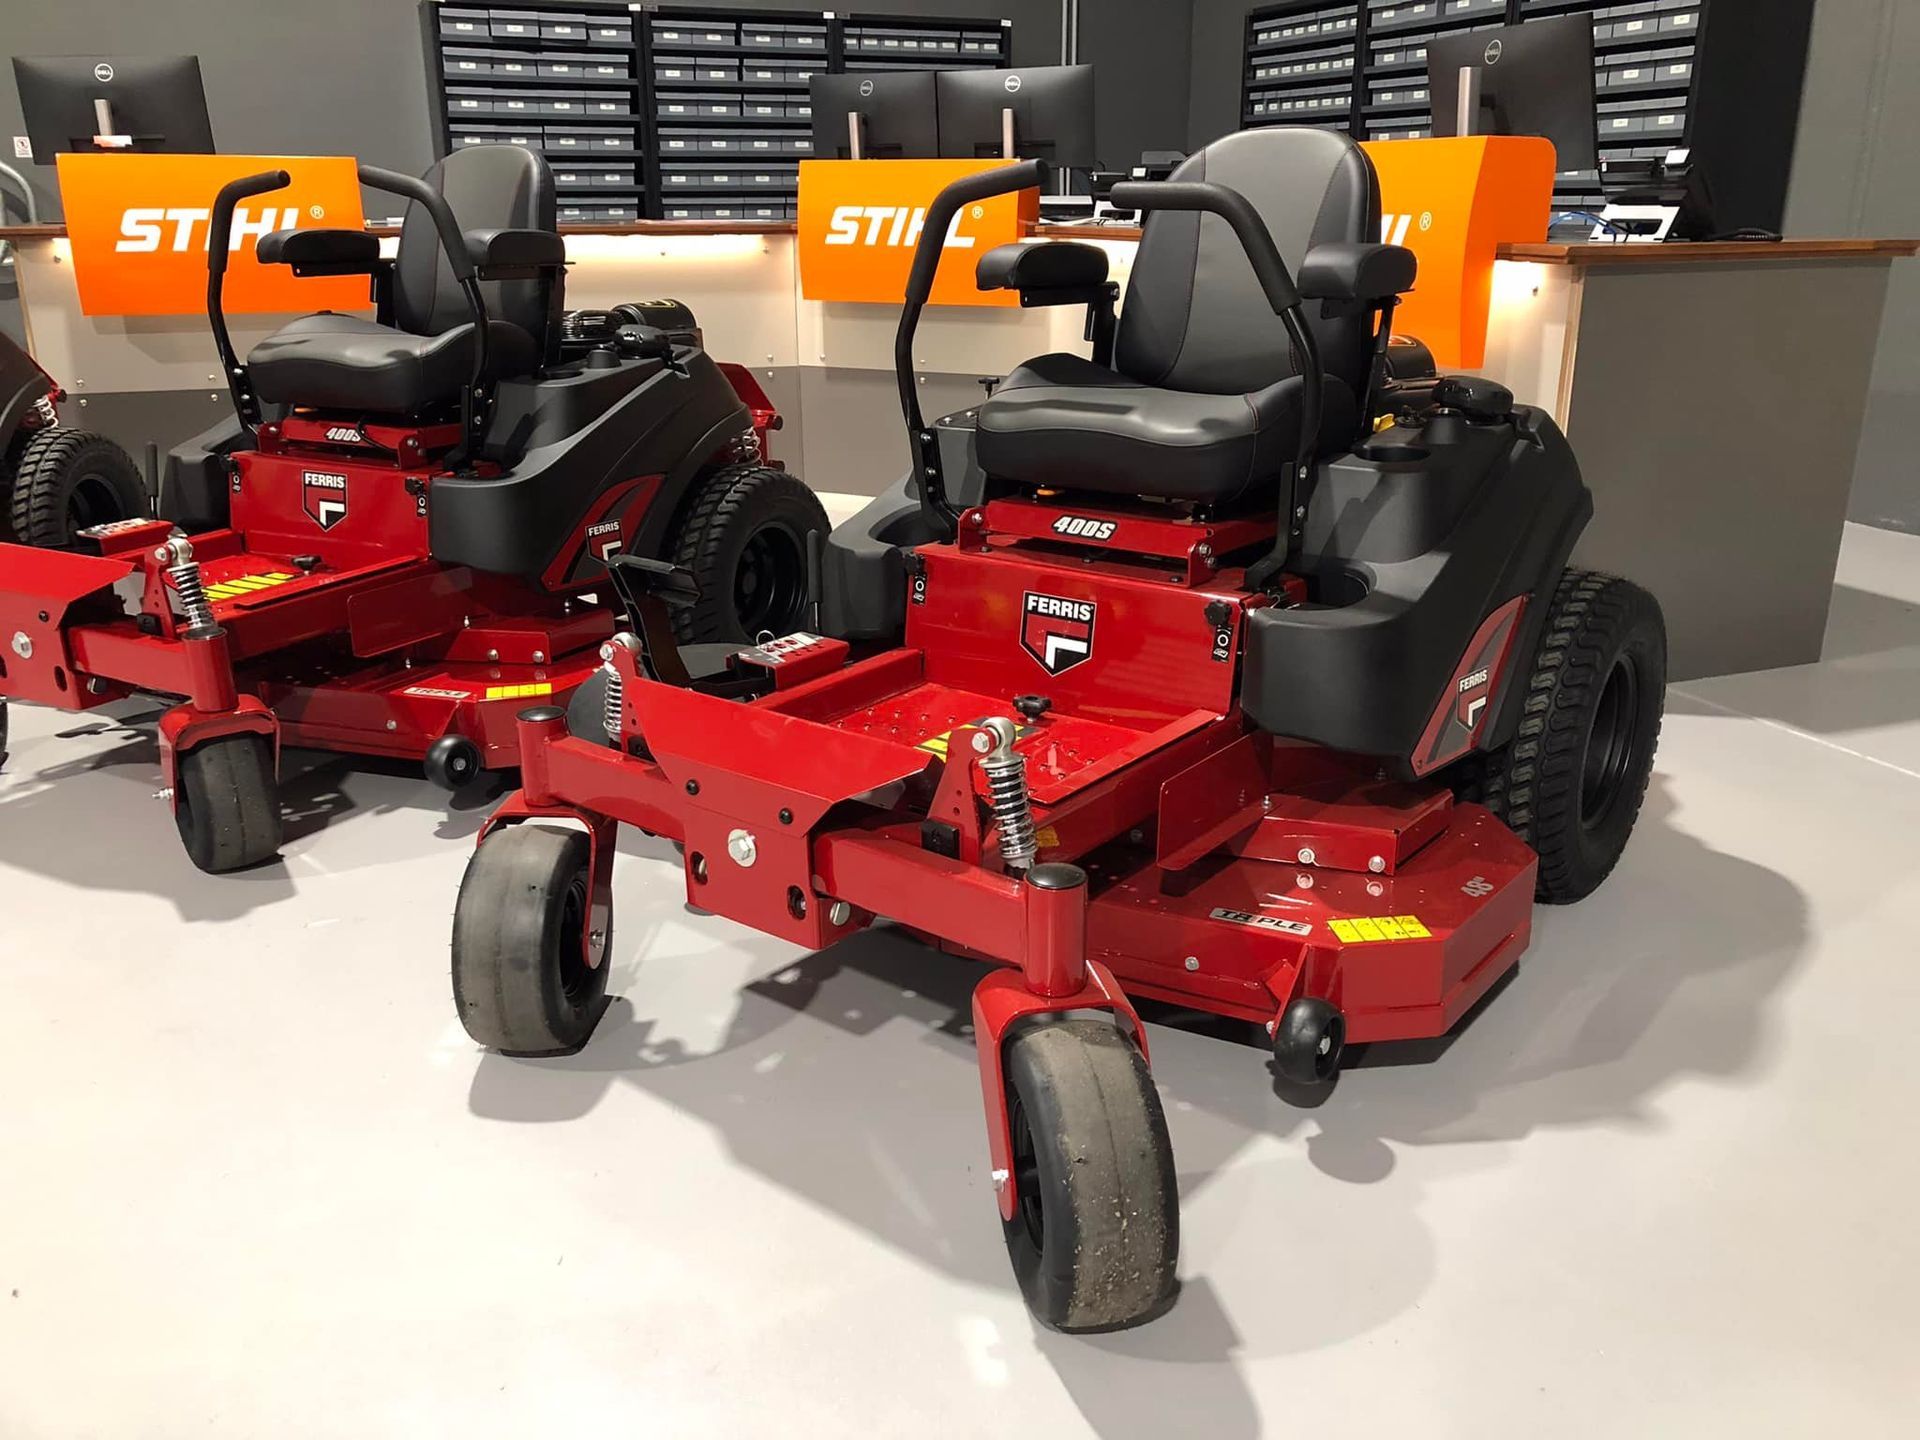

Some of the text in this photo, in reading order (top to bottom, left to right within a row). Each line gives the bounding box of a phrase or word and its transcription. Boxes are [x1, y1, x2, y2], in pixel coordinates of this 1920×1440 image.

[115, 208, 299, 252] STH
[304, 472, 345, 489] FERRIS
[588, 521, 620, 537] FERRIS
[1053, 516, 1116, 539] 400S
[1027, 595, 1092, 621] FERRIS
[1460, 669, 1488, 693] FERRIS
